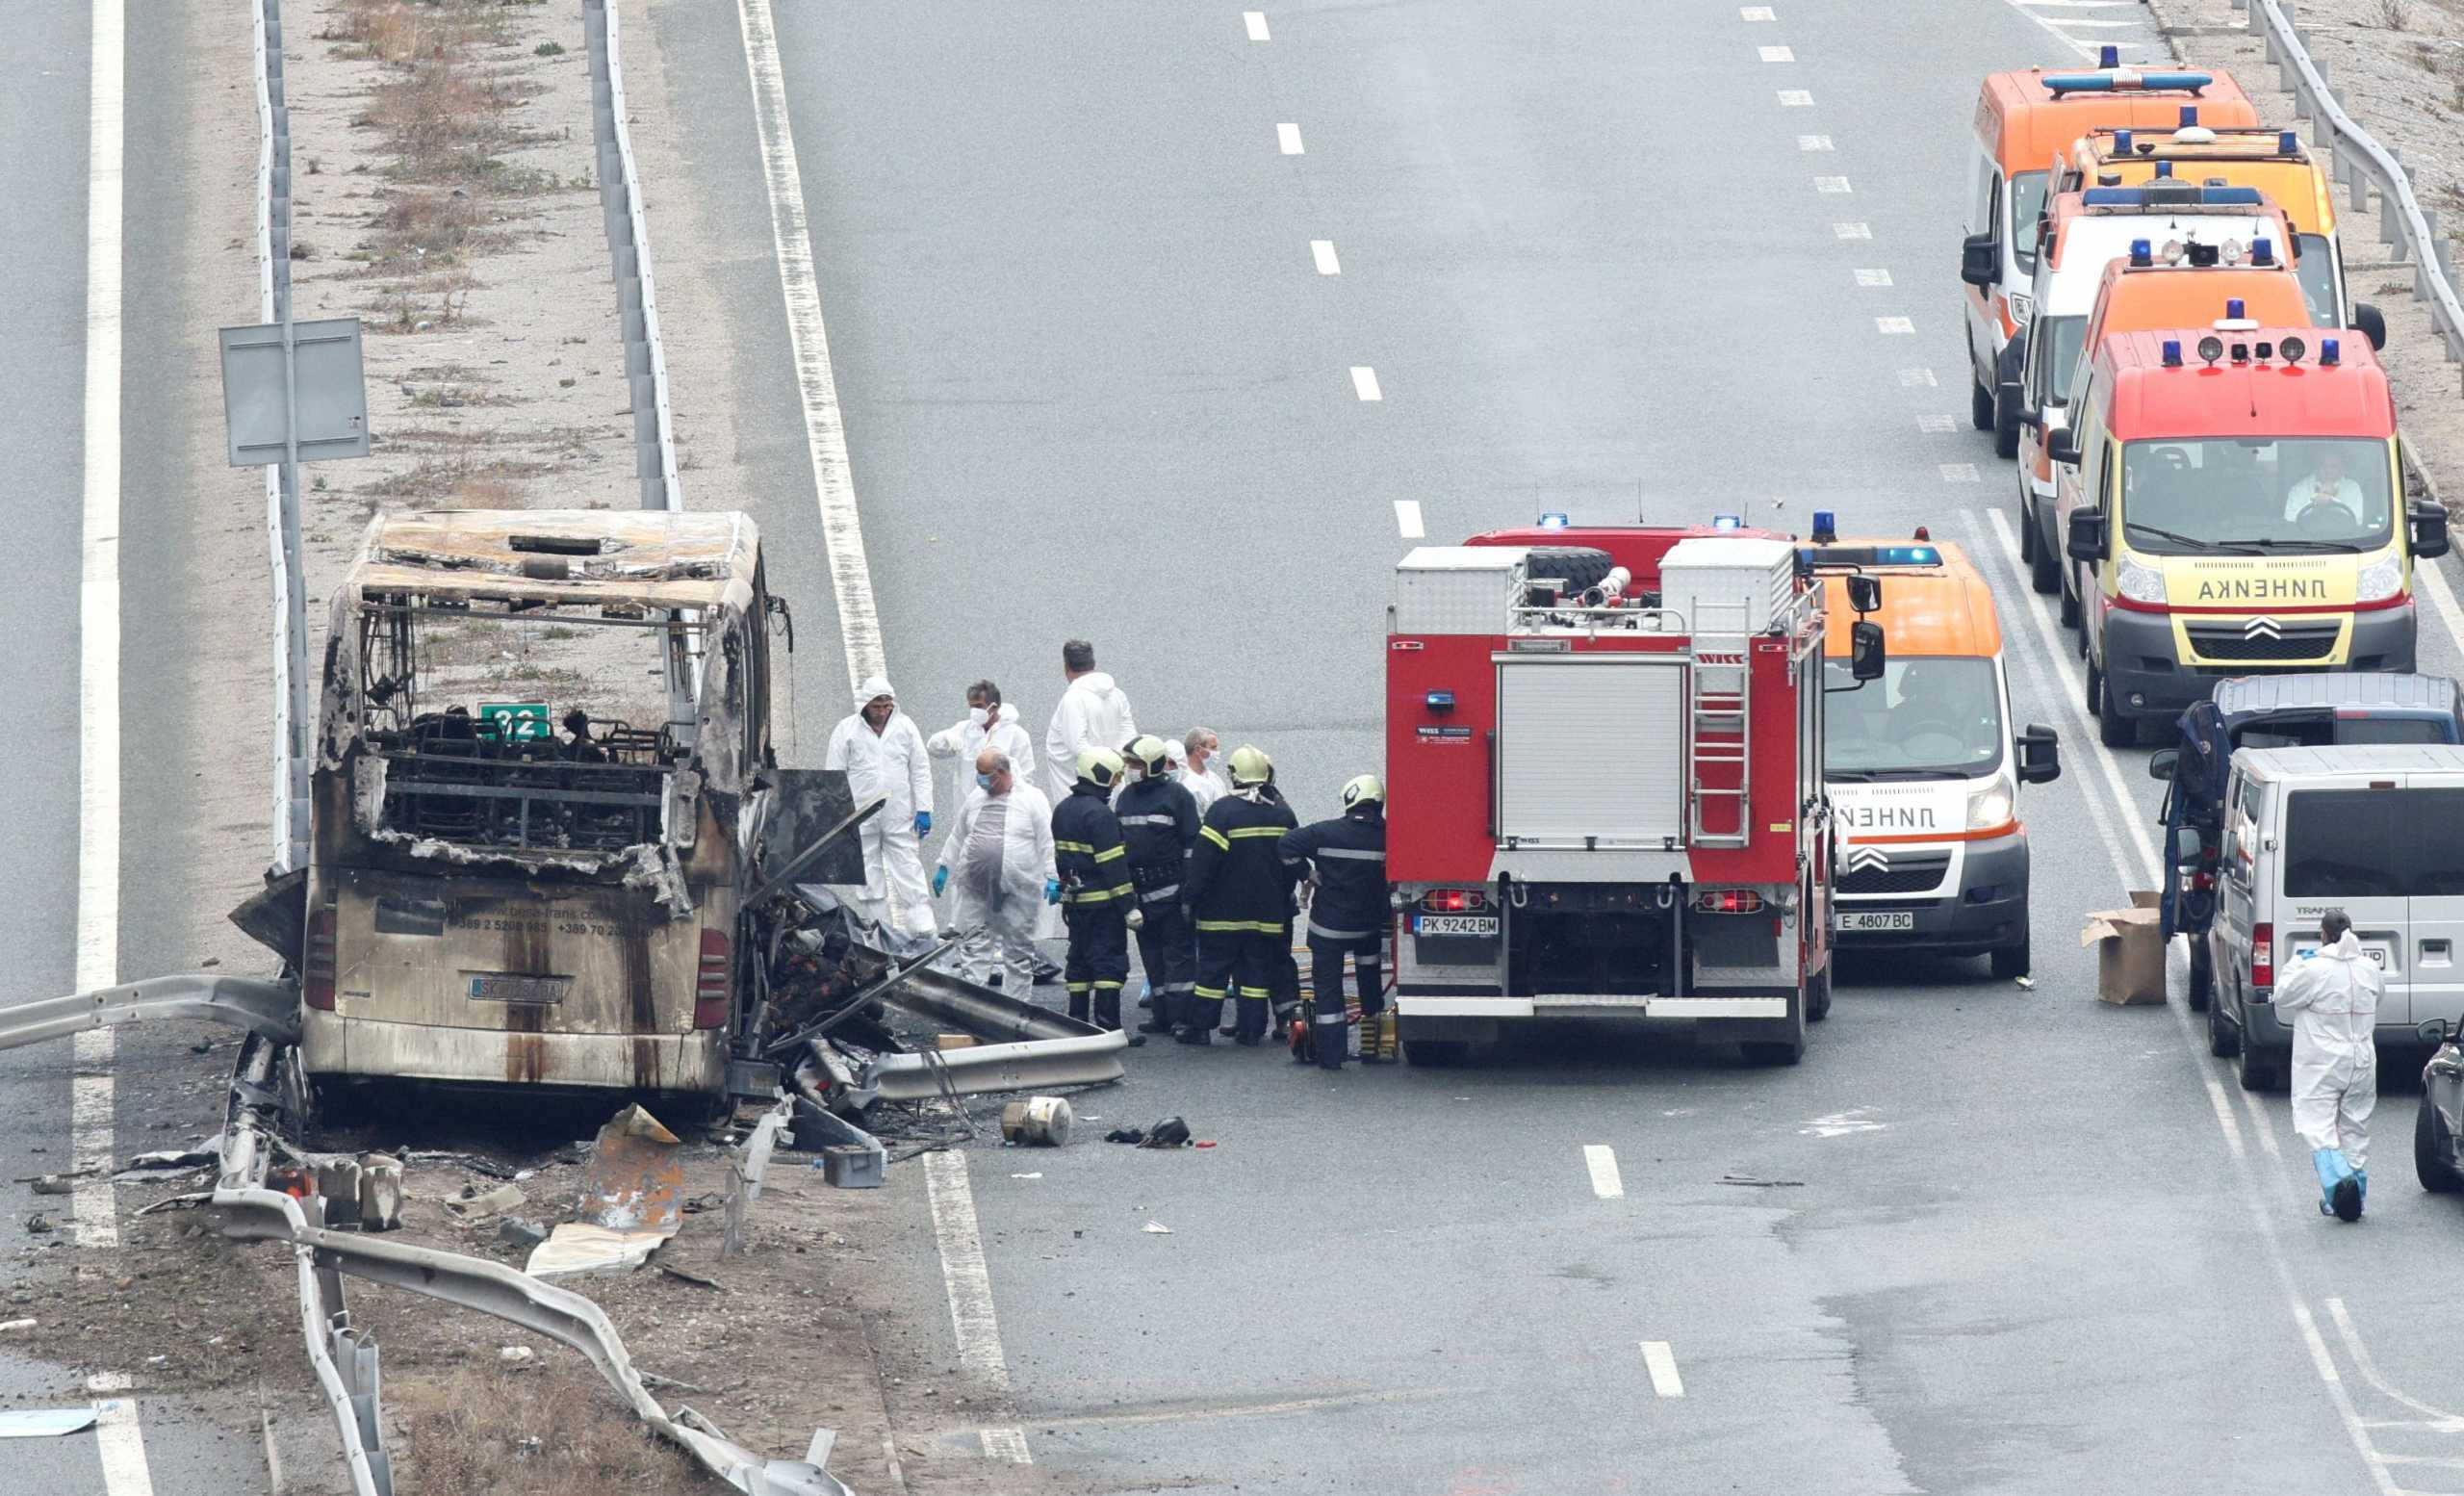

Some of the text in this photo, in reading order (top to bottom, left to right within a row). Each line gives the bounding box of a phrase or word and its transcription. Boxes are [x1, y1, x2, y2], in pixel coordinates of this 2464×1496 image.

[484, 920, 491, 929] 2
[590, 926, 604, 937] 70
[1423, 917, 1497, 932] PK 9242 BM
[1842, 916, 1912, 929] E 4807 BC
